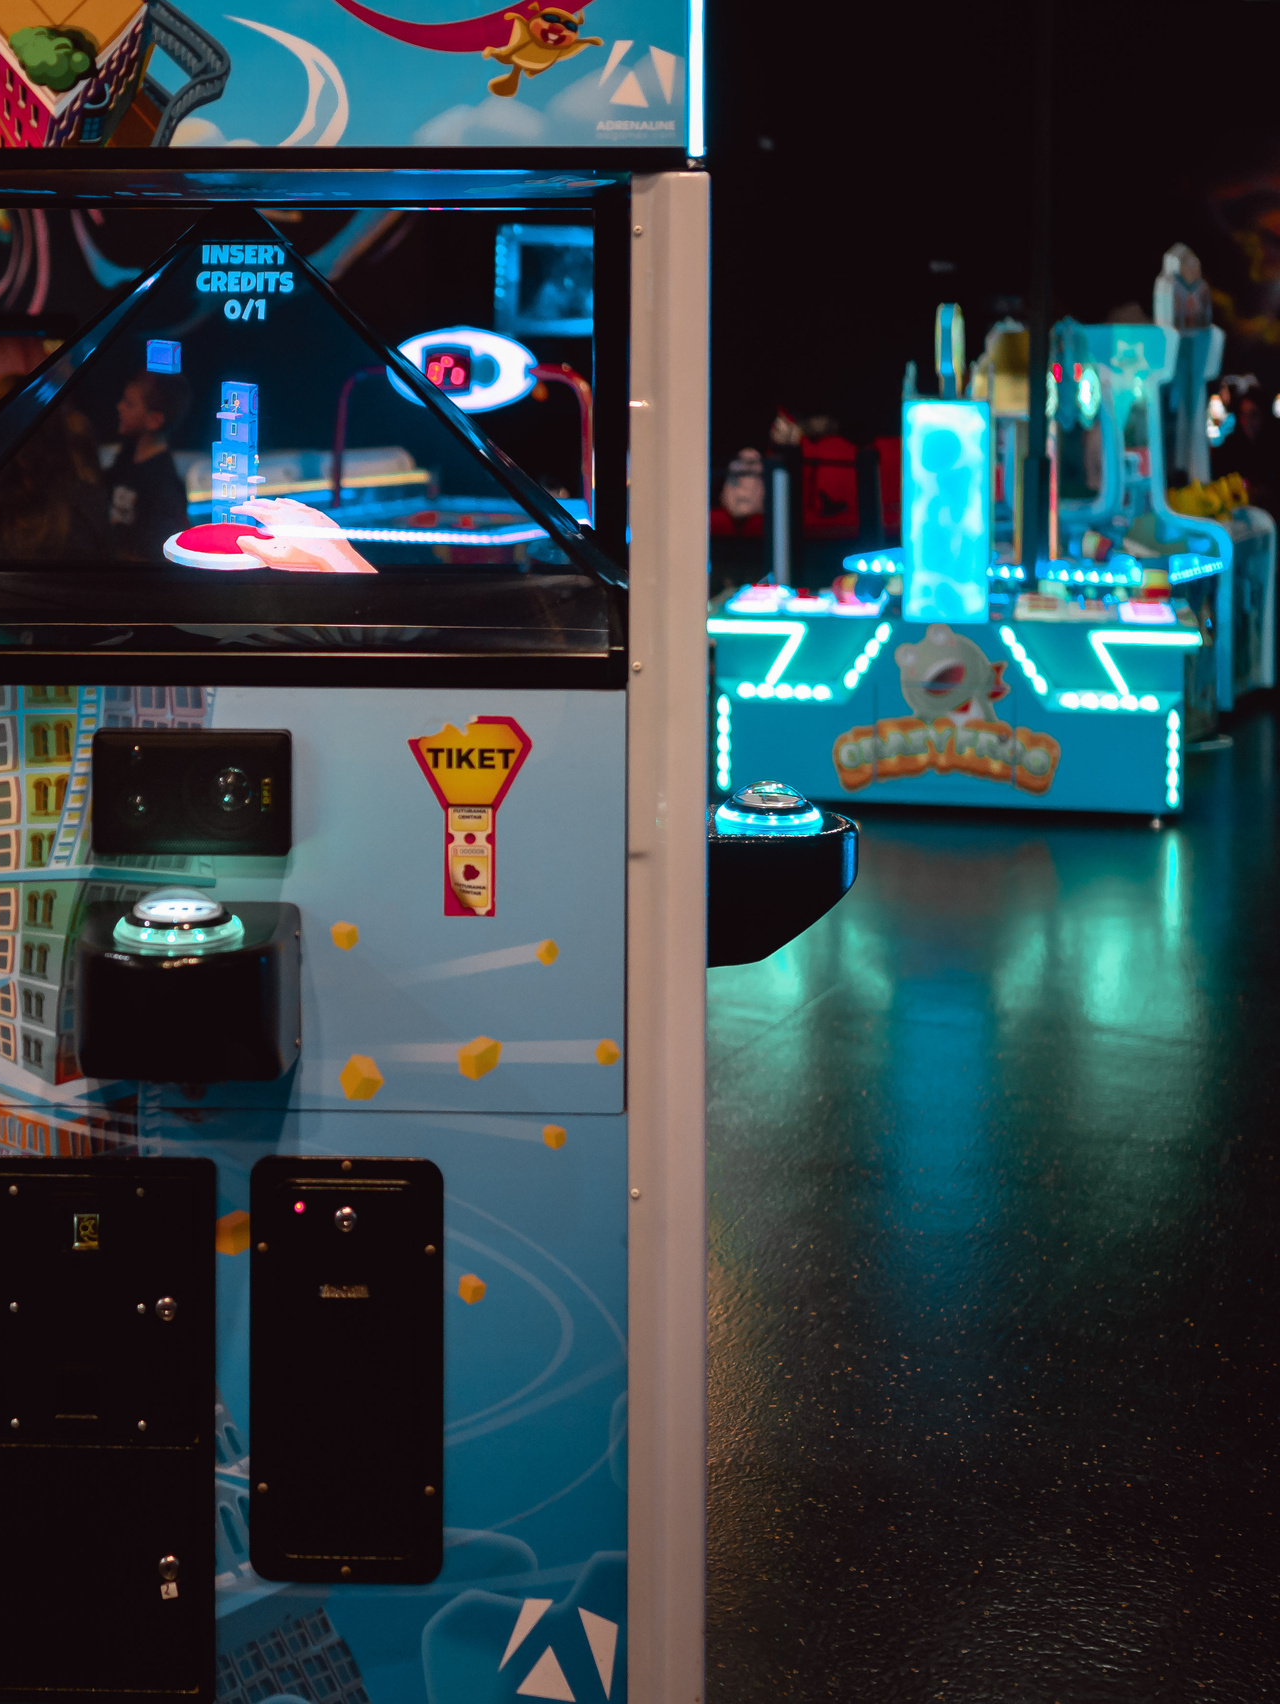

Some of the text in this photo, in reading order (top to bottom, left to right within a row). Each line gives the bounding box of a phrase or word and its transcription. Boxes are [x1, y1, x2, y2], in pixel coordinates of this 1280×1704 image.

[596, 120, 676, 131] ADRENALINE
[202, 244, 285, 266] INSERT
[196, 271, 294, 293] CREDITS
[223, 298, 266, 321] 0/1
[426, 747, 516, 769] TIKET
